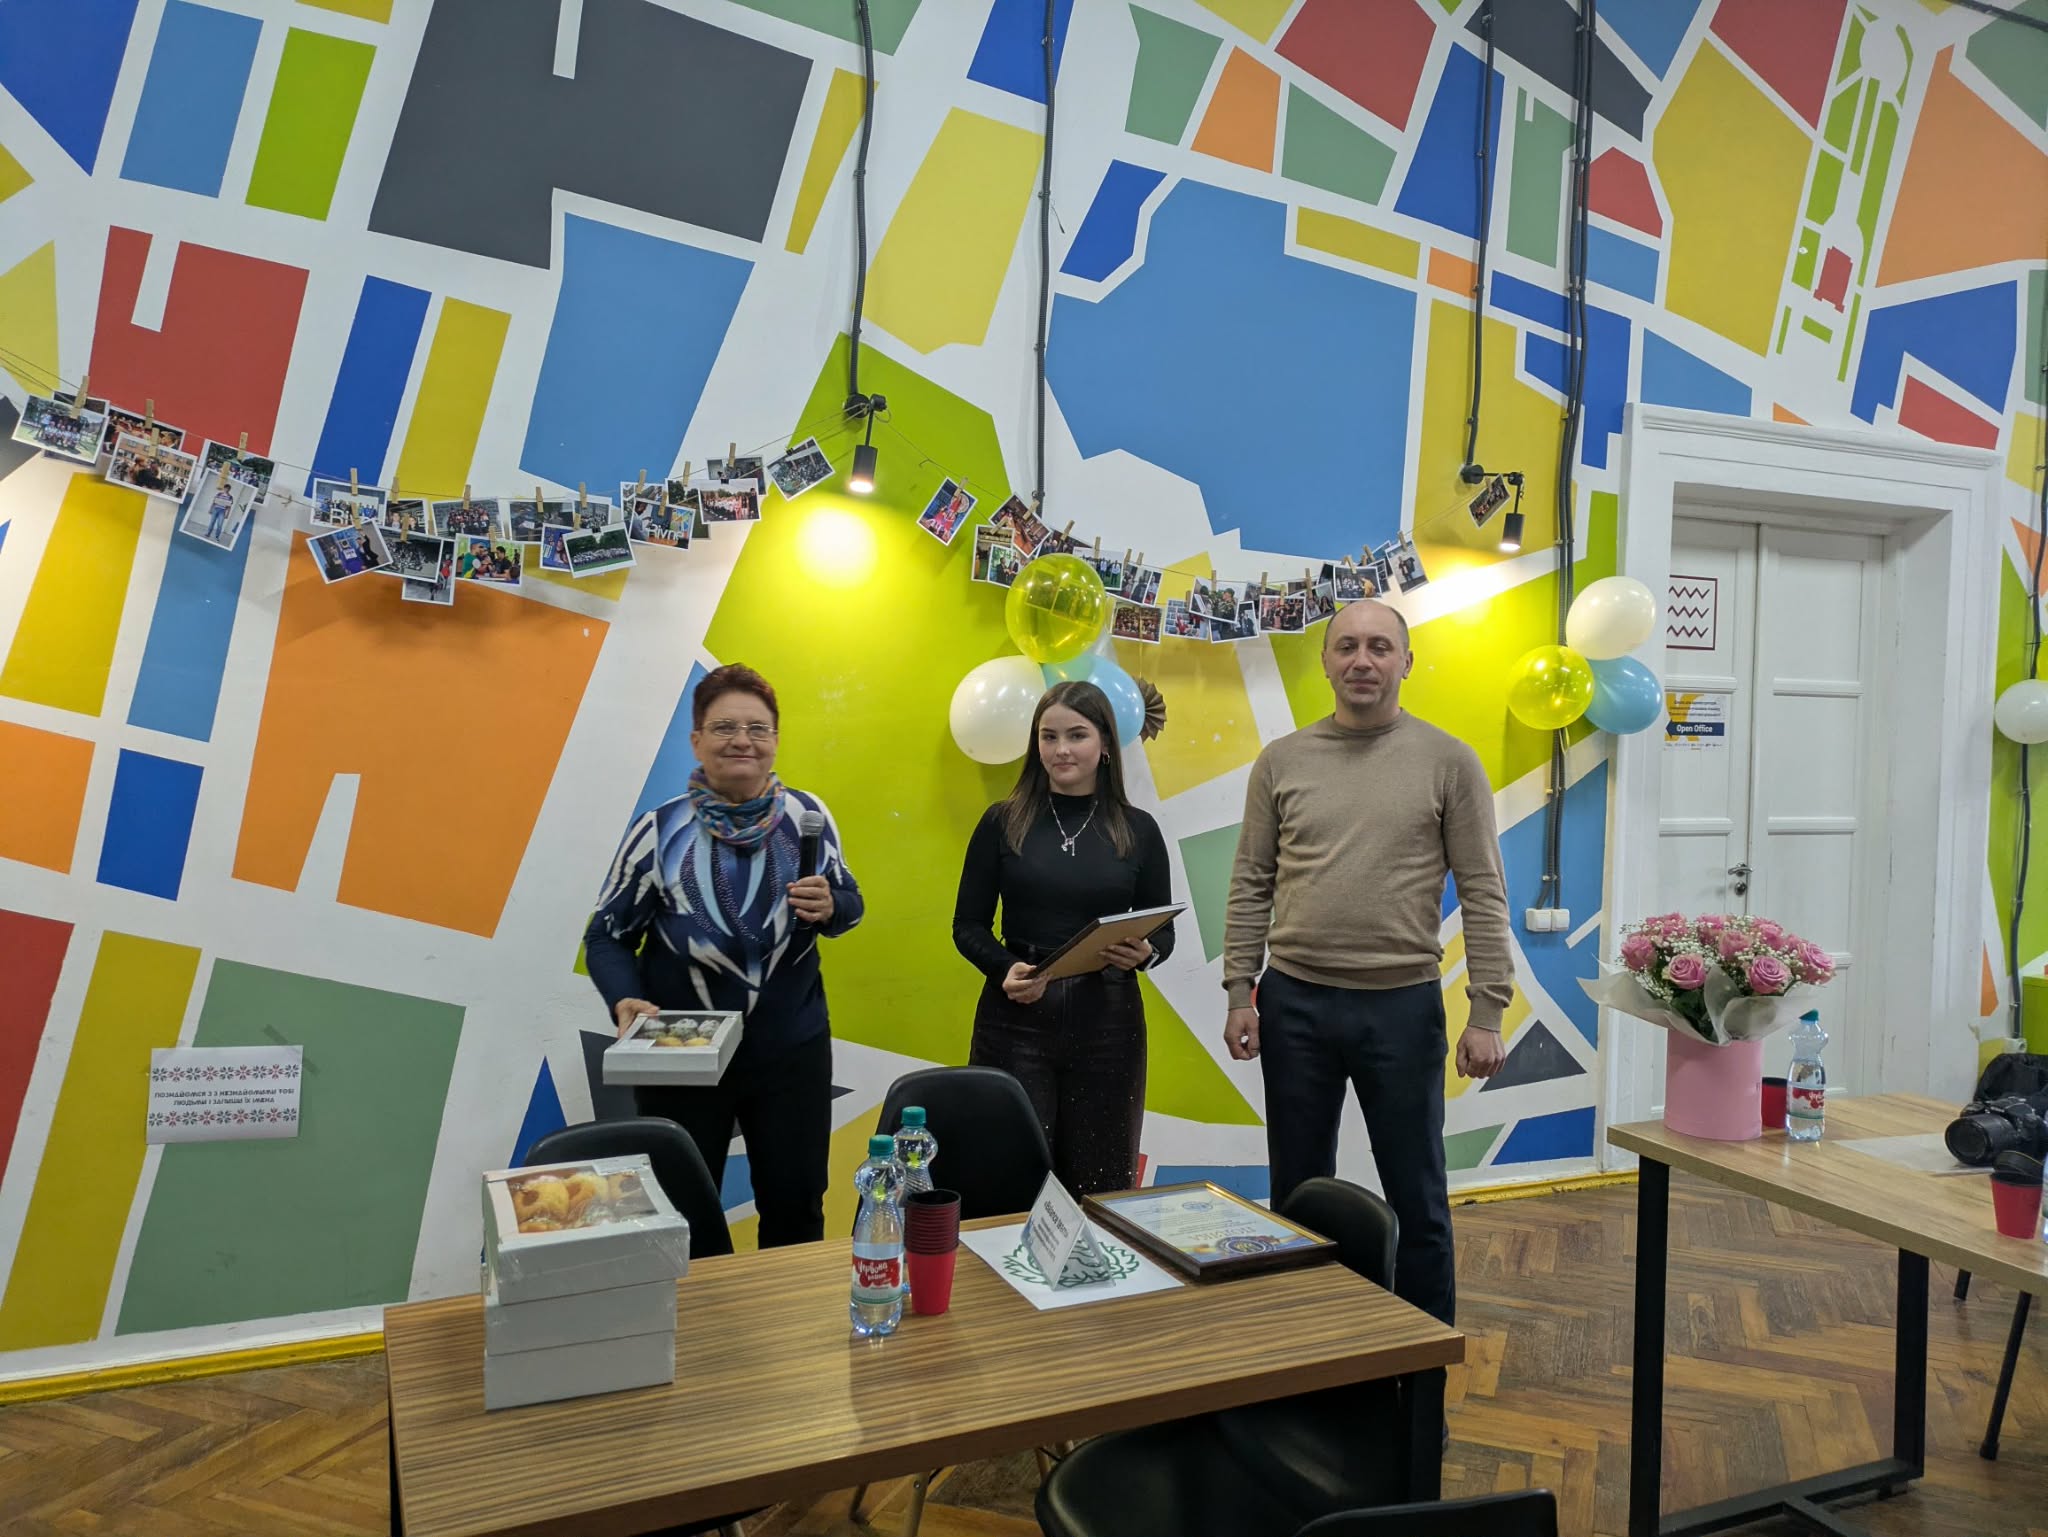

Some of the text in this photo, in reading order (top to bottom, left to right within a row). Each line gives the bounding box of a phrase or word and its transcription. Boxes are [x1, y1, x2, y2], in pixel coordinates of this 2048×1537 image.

[648, 523, 683, 541] Rivne
[1676, 724, 1713, 734] Open Office
[154, 1090, 206, 1098] ПОЗНАЙОМСЯ
